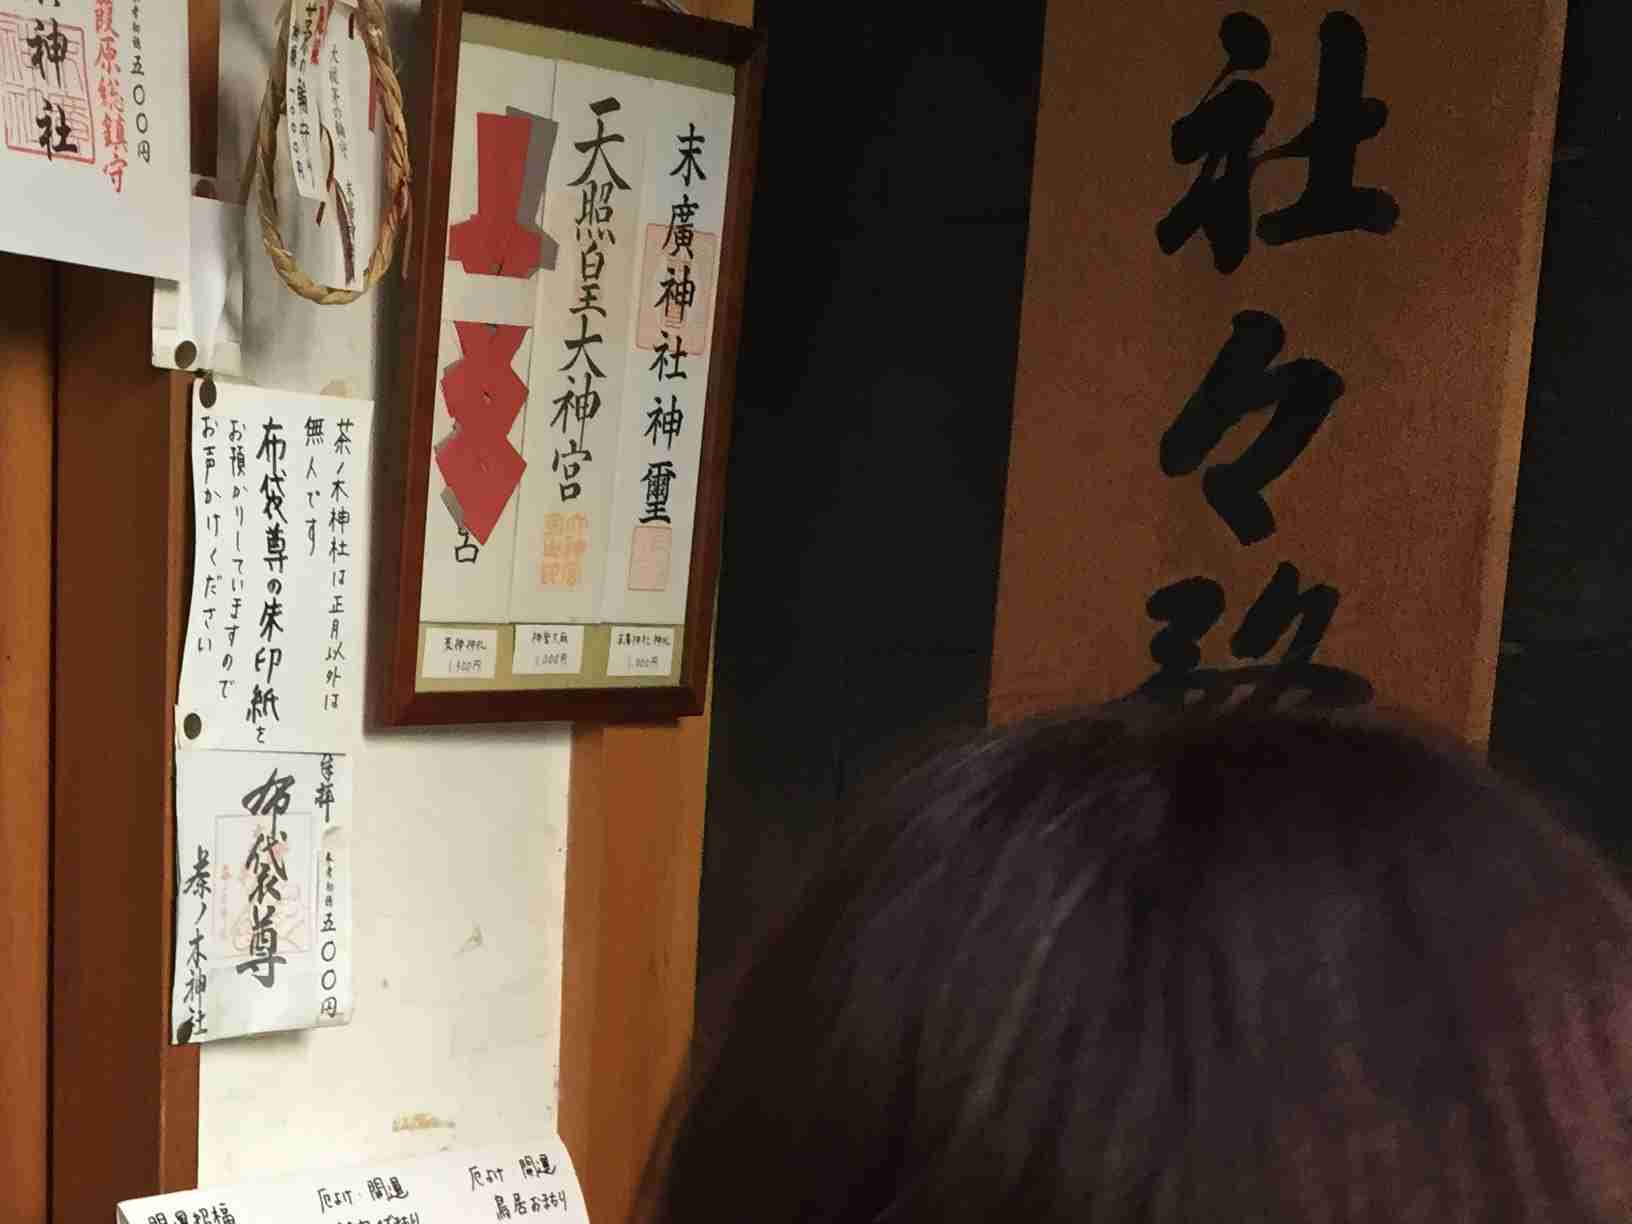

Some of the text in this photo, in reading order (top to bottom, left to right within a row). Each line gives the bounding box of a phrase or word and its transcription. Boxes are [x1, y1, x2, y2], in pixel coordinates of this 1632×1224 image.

[549, 97, 633, 502] 天照皇大神宮
[304, 416, 325, 557] 無人です
